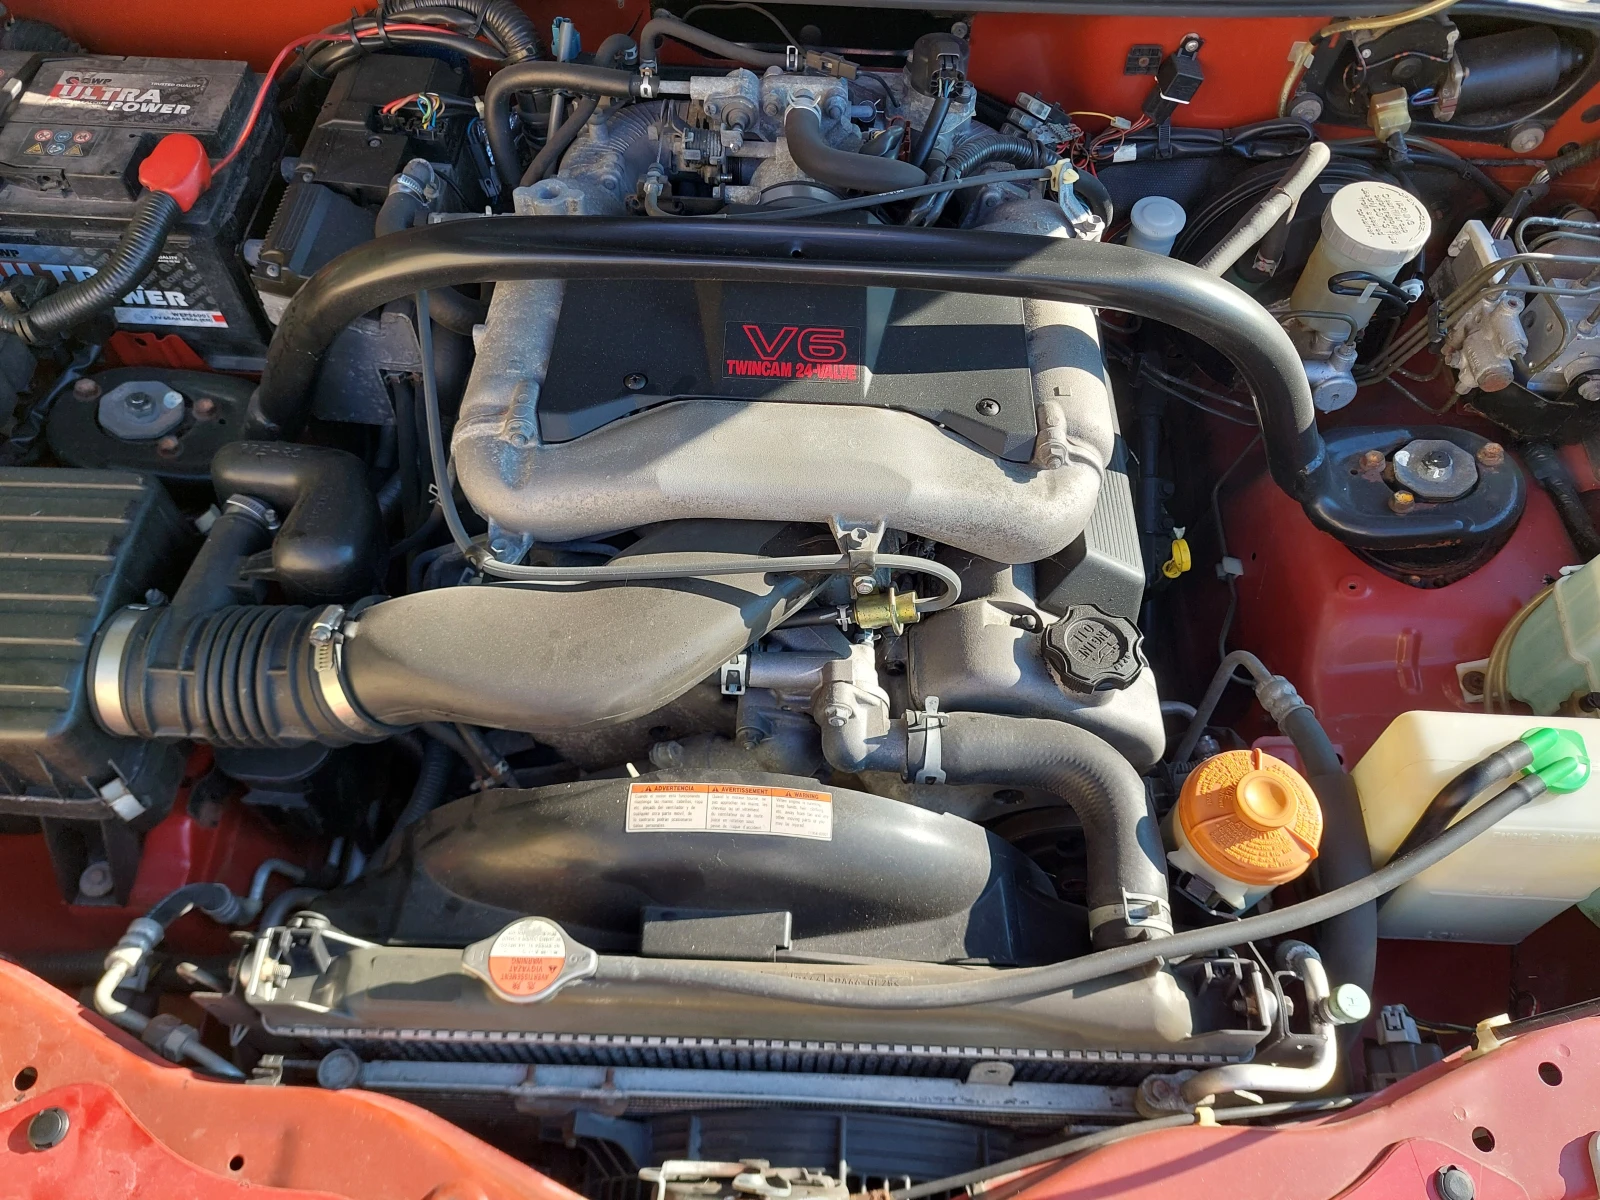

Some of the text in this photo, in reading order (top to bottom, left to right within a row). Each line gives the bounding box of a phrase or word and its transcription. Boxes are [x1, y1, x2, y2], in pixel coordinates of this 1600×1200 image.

[59, 85, 160, 103] ULTRA
[106, 100, 191, 115] POWER
[0, 249, 19, 257] WP
[742, 325, 847, 363] V6
[726, 359, 857, 381] TWINCAM 24-VALVE
[1070, 623, 1095, 646] OIL
[1074, 626, 1111, 662] ENGINE
